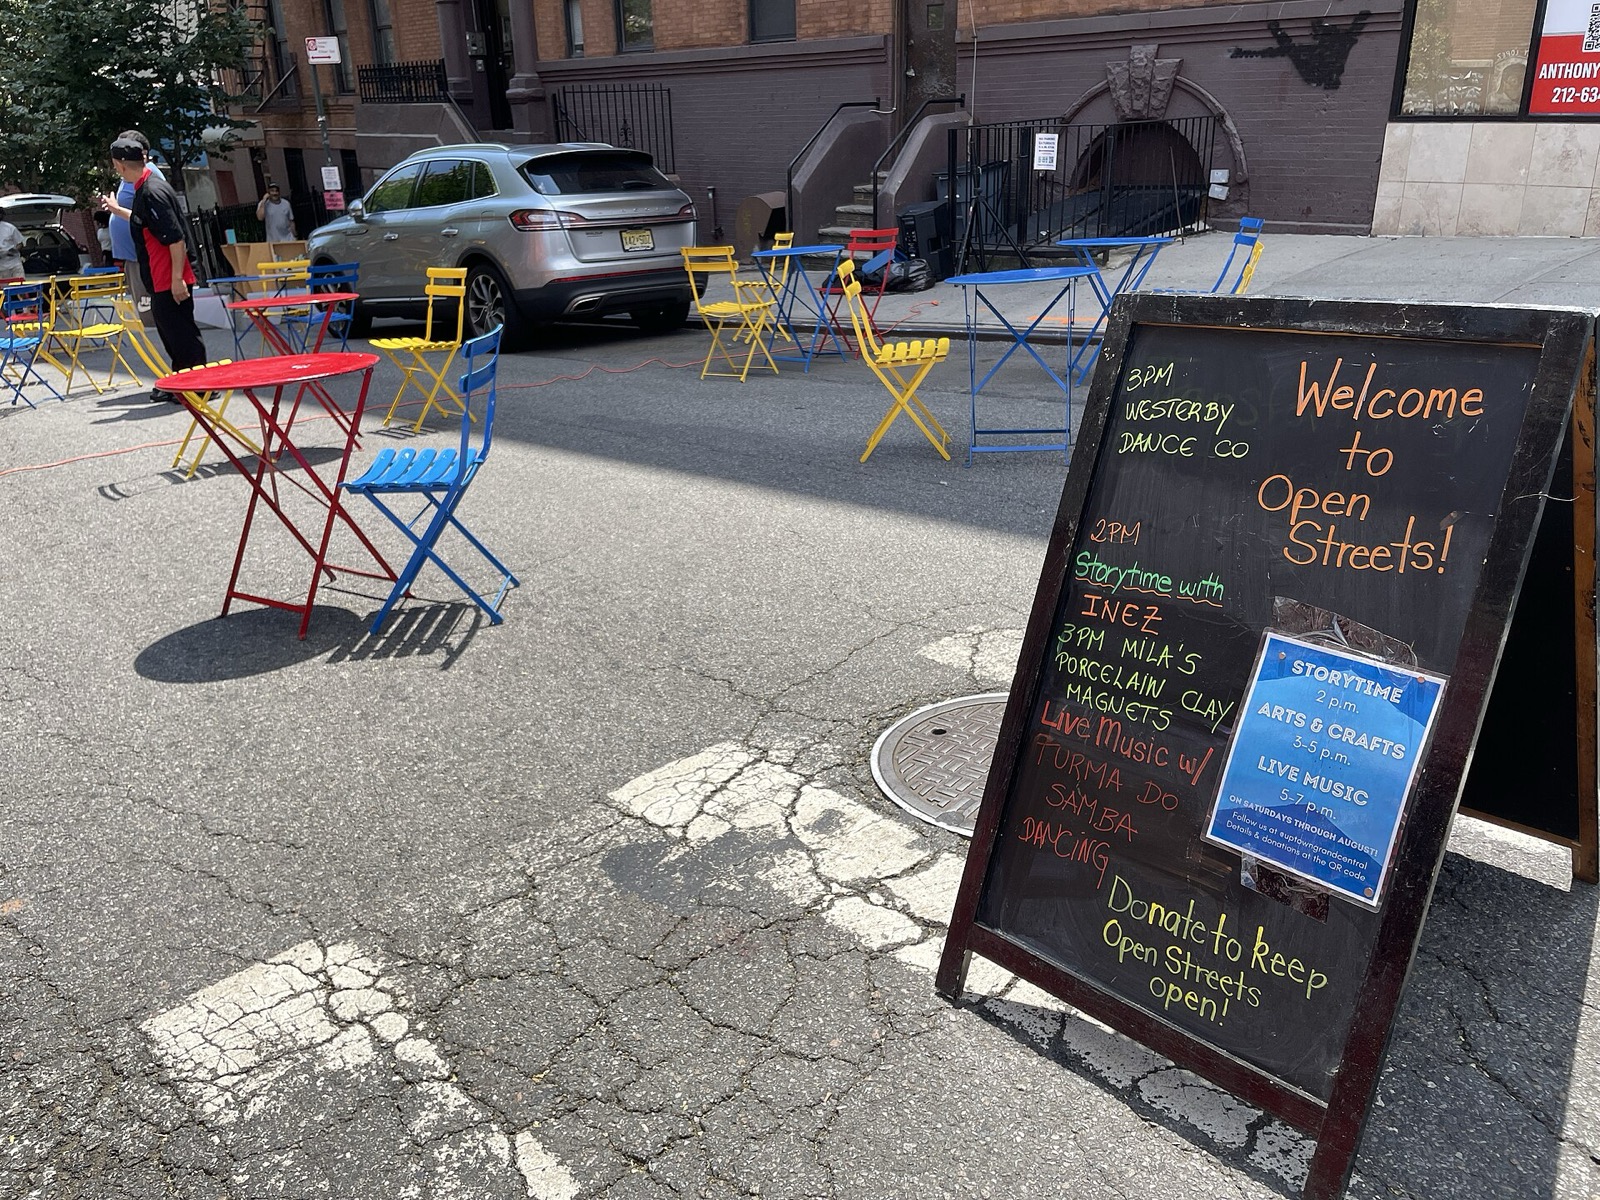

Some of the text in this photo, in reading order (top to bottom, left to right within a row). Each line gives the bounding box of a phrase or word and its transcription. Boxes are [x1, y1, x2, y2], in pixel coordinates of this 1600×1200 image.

[1538, 62, 1600, 79] ANTHONY
[1551, 86, 1600, 103] 212-63
[1126, 362, 1174, 392] 3PM
[1296, 357, 1484, 421] Welcome
[1125, 398, 1235, 436] WESTERBY
[1118, 432, 1250, 459] DANCE CO
[1339, 430, 1394, 477] to
[1257, 474, 1371, 526] Open
[1090, 518, 1141, 546] 2PM
[1283, 515, 1454, 574] Streets!
[1075, 551, 1225, 601] Storytime with
[1057, 623, 1106, 652] 3PM
[1081, 593, 1163, 636] INEZ
[1291, 659, 1403, 705] STORYTIME
[1315, 690, 1359, 714] 2 p.m.
[1066, 683, 1173, 731] MAGNETS
[1181, 690, 1235, 734] CLAY
[1040, 700, 1214, 786] Live Music w/
[1257, 702, 1406, 760] ARTS & CRAFTS
[1292, 735, 1351, 766] 3-5 p.m.
[1035, 739, 1179, 811] TURMA DO
[1257, 755, 1369, 806] LIVE MUSIC
[1045, 783, 1139, 842] SAMBA
[1229, 794, 1379, 857] ON SATURDAYS THROUGH AUGUST!
[1232, 811, 1258, 827] Follow
[1258, 823, 1268, 832] us
[1268, 825, 1279, 835] at
[1279, 788, 1337, 820] 5-7 p.m.
[1226, 820, 1366, 882] Details & donations at the QR code
[1107, 874, 1329, 1001] Donate to keep
[1102, 919, 1262, 1008] Open Streets
